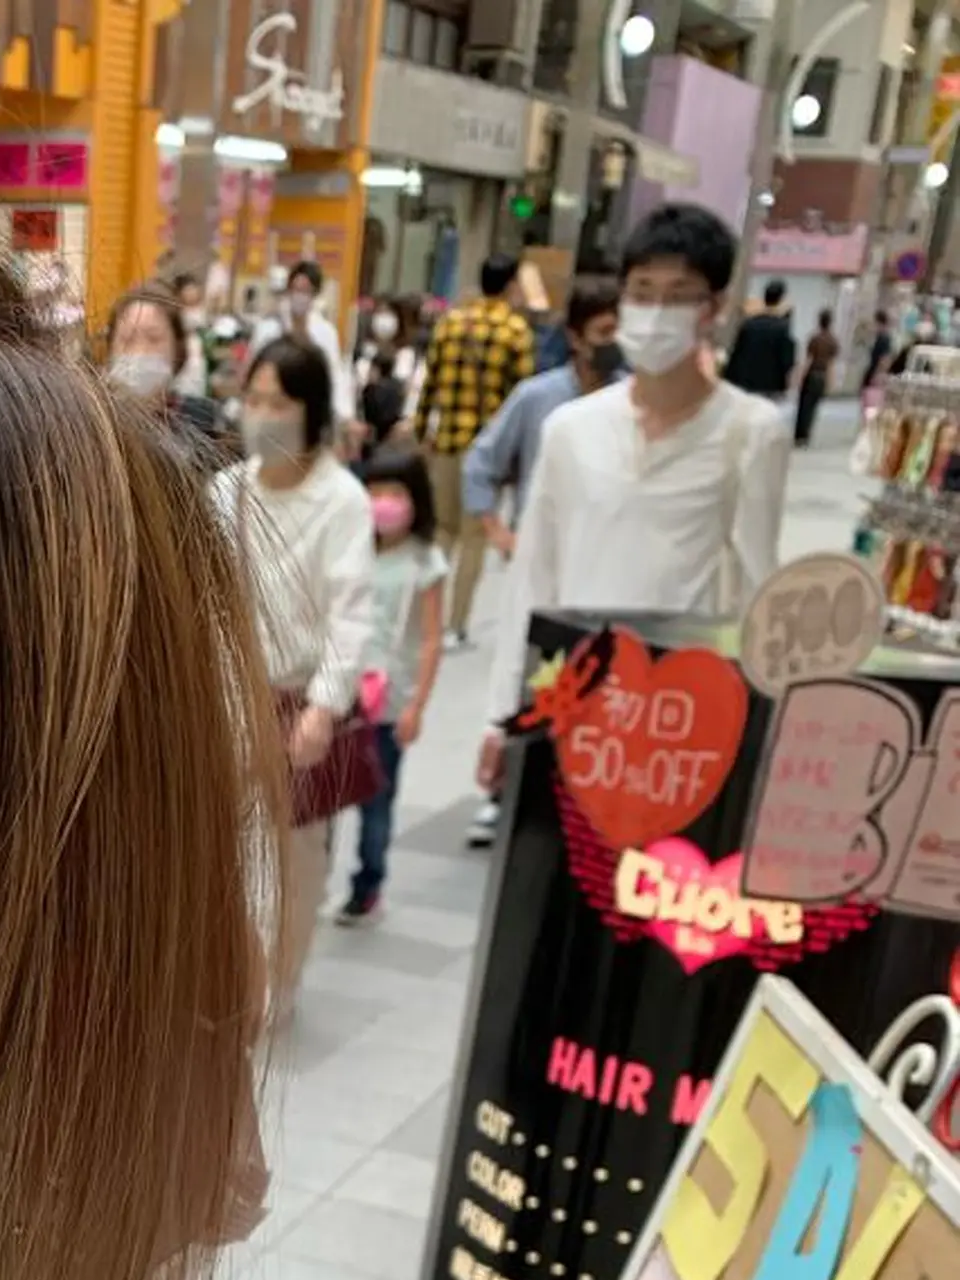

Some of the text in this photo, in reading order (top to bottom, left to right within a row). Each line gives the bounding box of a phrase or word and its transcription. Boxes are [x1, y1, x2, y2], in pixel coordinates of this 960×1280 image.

[599, 673, 695, 741] 初回
[615, 847, 805, 945] Cuore
[547, 1036, 653, 1116] HAIR
[476, 1100, 514, 1145] CUT
[467, 1151, 526, 1212] COLOR
[457, 1199, 506, 1254] PERM
